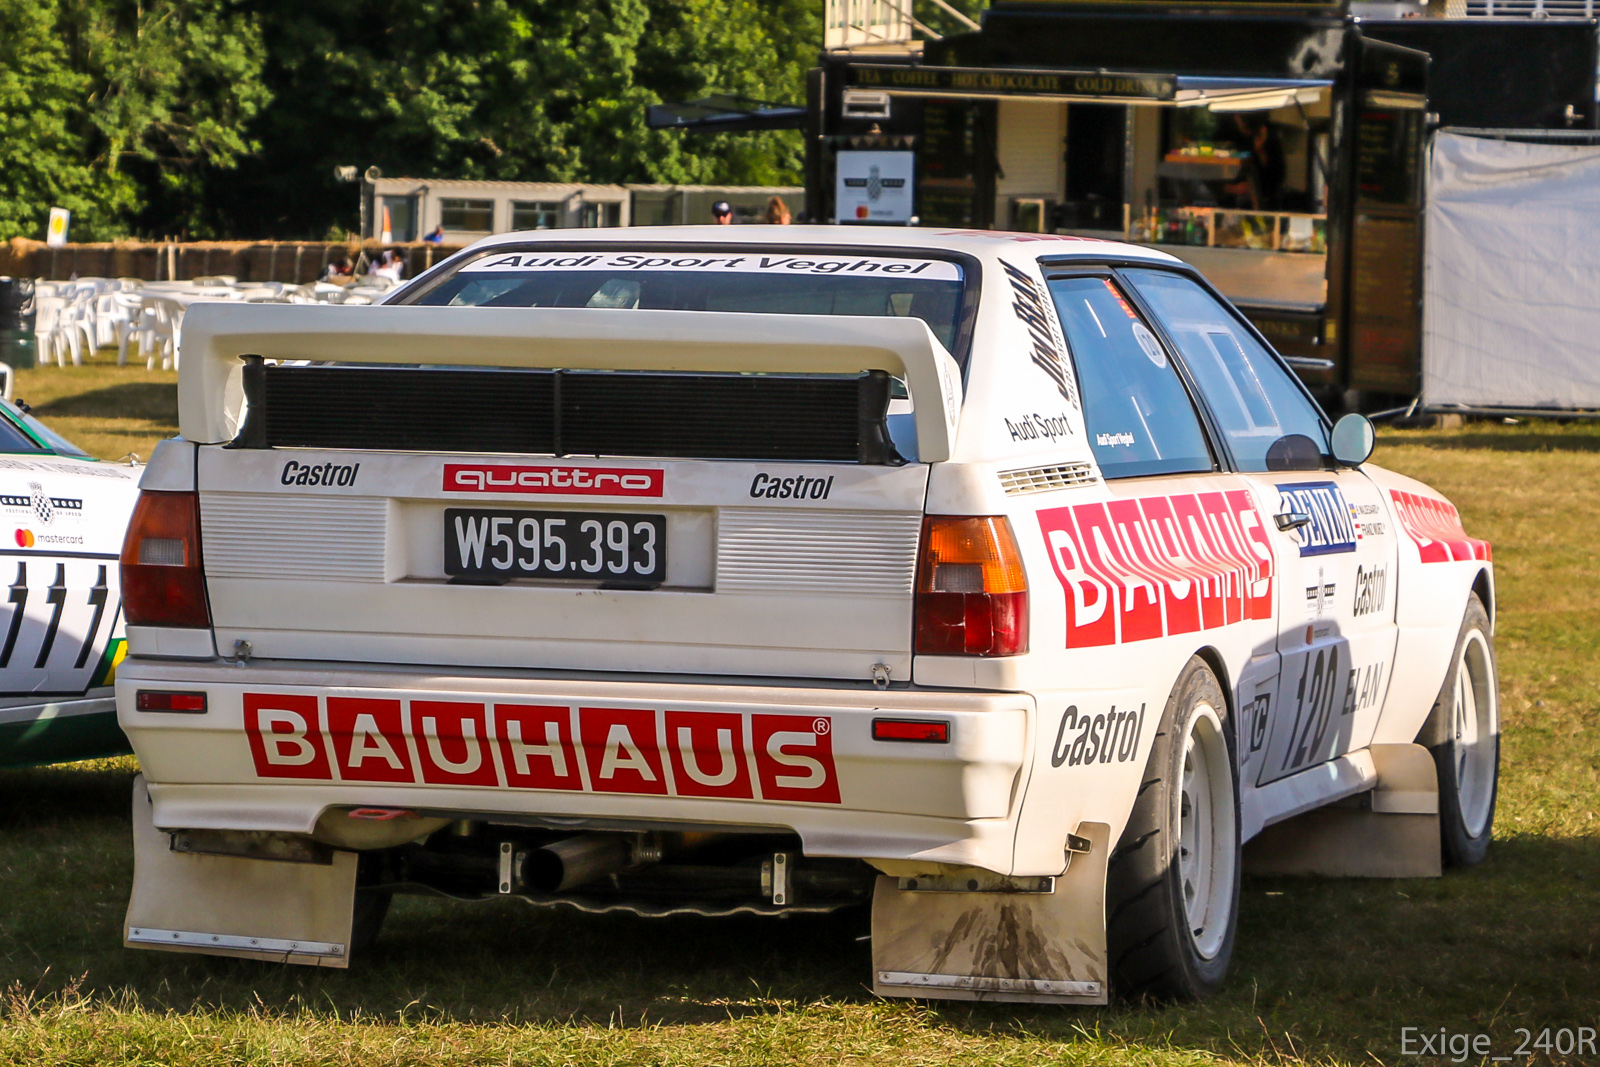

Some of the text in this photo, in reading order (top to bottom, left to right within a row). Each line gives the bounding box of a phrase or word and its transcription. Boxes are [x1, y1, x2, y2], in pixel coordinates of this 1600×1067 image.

[483, 254, 934, 275] Audi Sport Veghel
[996, 256, 1052, 339] BEAM
[1004, 411, 1073, 443] Audi Sport
[280, 460, 360, 488] Castrol
[454, 467, 653, 491] quattro
[749, 472, 835, 501] Castrol
[37, 533, 84, 545] mastercard
[454, 514, 657, 576] W595.393
[1280, 487, 1356, 548] DENIM
[1047, 508, 1271, 628] BAUHAUS
[1353, 562, 1388, 617] Castrol
[1051, 702, 1146, 769] Castrol
[1281, 644, 1338, 771] 120
[1341, 661, 1384, 716] ELAN
[257, 708, 827, 790] BAUHAUS
